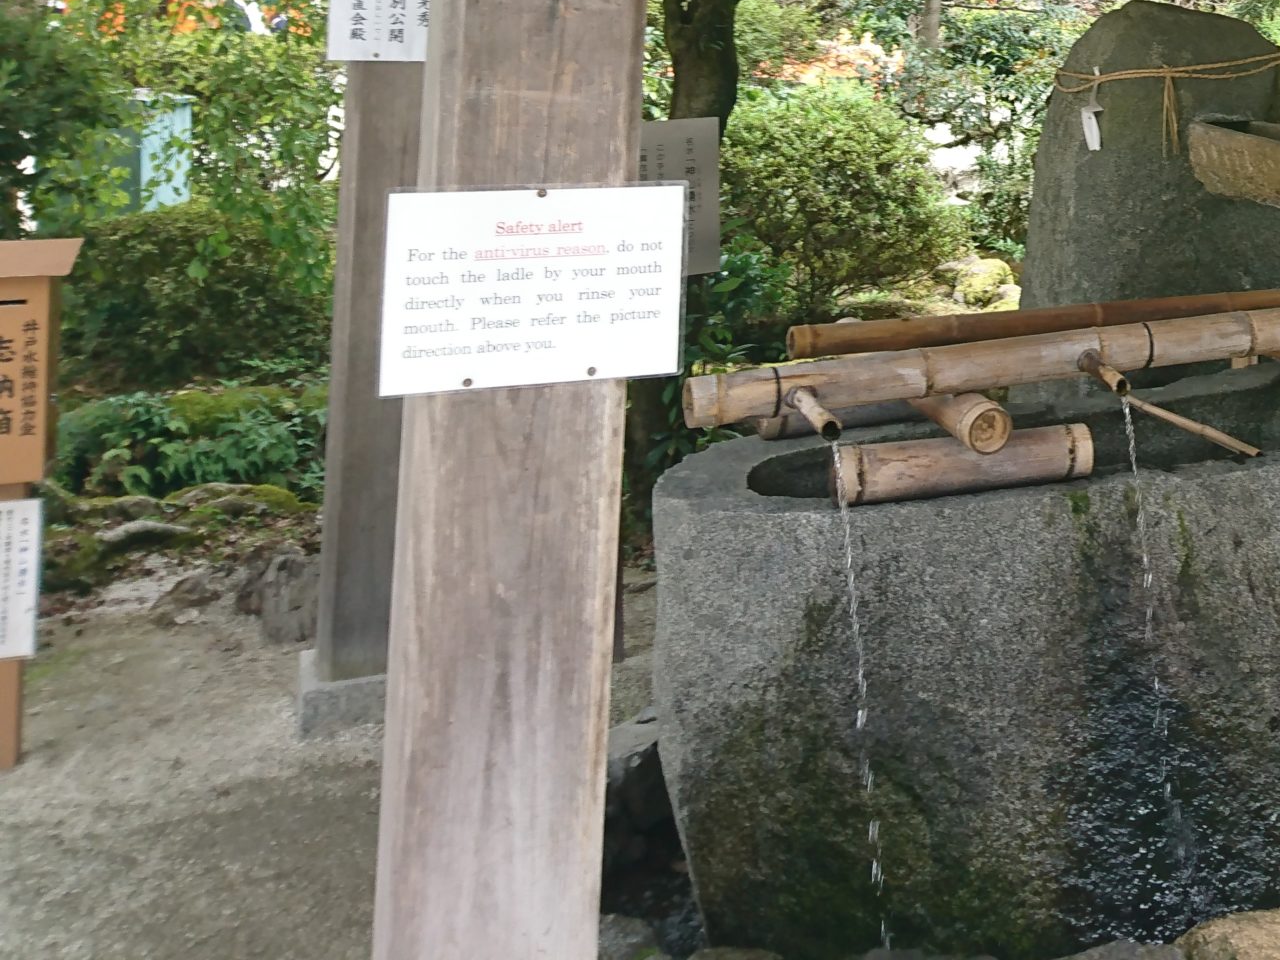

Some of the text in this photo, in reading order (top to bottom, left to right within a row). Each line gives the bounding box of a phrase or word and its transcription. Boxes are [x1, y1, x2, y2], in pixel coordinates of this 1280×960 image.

[495, 219, 584, 236] Safety alert
[407, 248, 436, 262] For
[442, 247, 468, 261] the
[474, 246, 550, 260] anti-virus
[617, 239, 634, 253] do
[641, 241, 663, 252] not
[405, 260, 662, 286] touch the ladle by your mouth
[405, 286, 662, 310] directly when you rinse your
[470, 316, 520, 330] Please
[530, 312, 567, 327] refer
[576, 310, 600, 323] the
[610, 308, 661, 325] picture
[402, 344, 472, 359] direction
[477, 340, 521, 354] above
